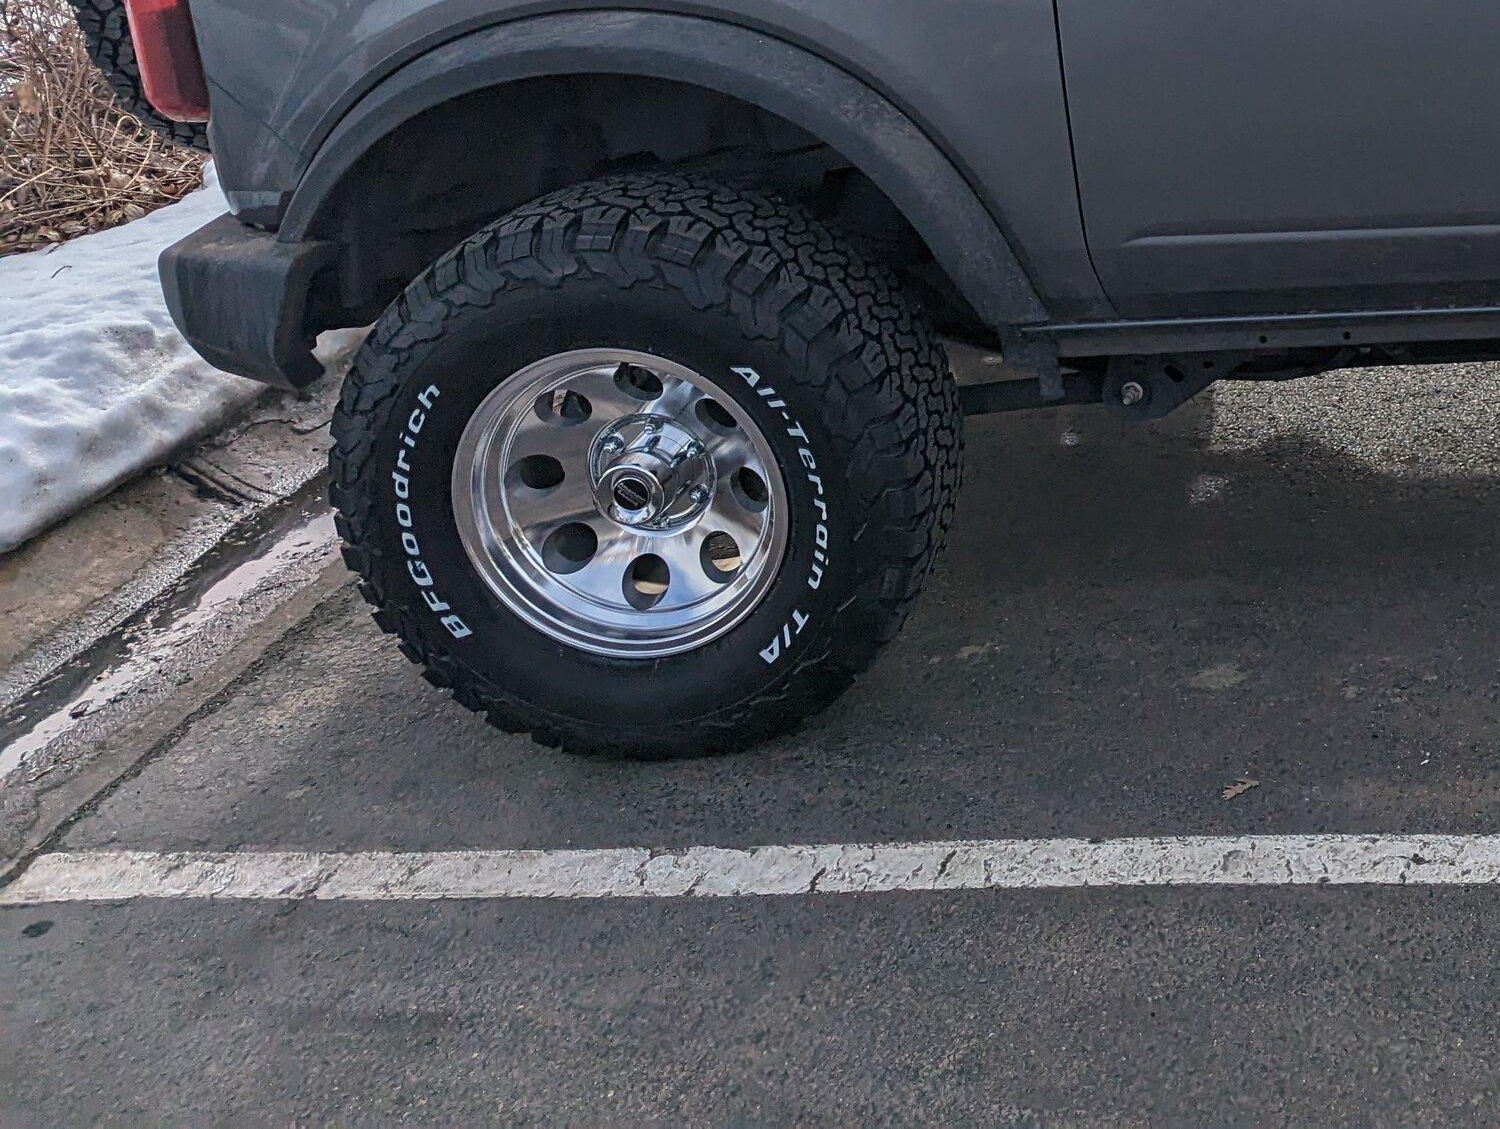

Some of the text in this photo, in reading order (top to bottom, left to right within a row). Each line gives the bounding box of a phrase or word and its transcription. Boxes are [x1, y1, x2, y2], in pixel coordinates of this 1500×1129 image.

[392, 383, 473, 639] BFGoodrich
[730, 367, 829, 664] All-Terrain T/A
